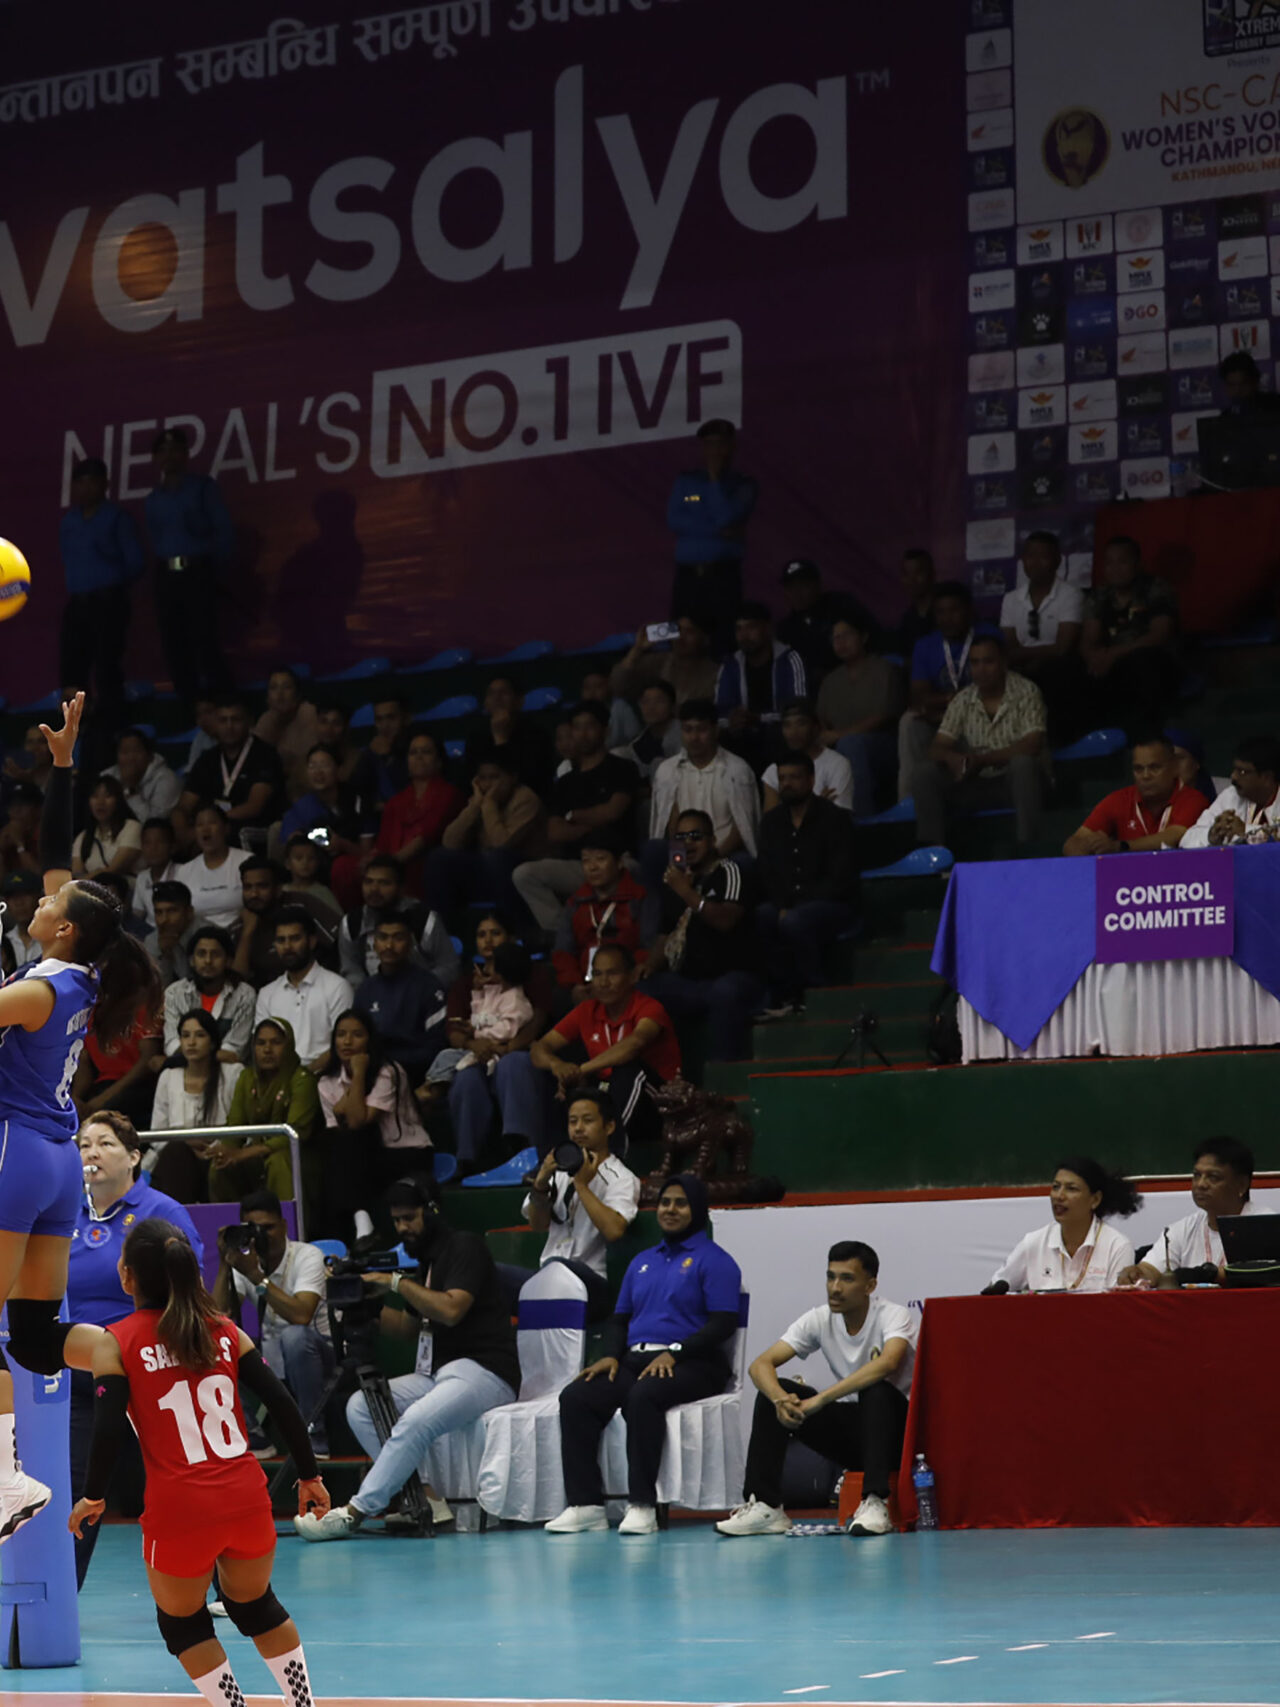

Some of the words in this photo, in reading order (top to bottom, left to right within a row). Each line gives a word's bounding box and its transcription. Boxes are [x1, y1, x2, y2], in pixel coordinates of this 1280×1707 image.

[856, 68, 891, 94] TM
[1121, 116, 1236, 151] WOMEN'S
[60, 391, 362, 509] NEPAL'S
[386, 356, 569, 466] NO.1
[597, 336, 730, 435] IVF
[1115, 881, 1214, 906] CONTROL
[1104, 906, 1226, 932] COMMITTEE
[157, 1374, 249, 1466] 18
